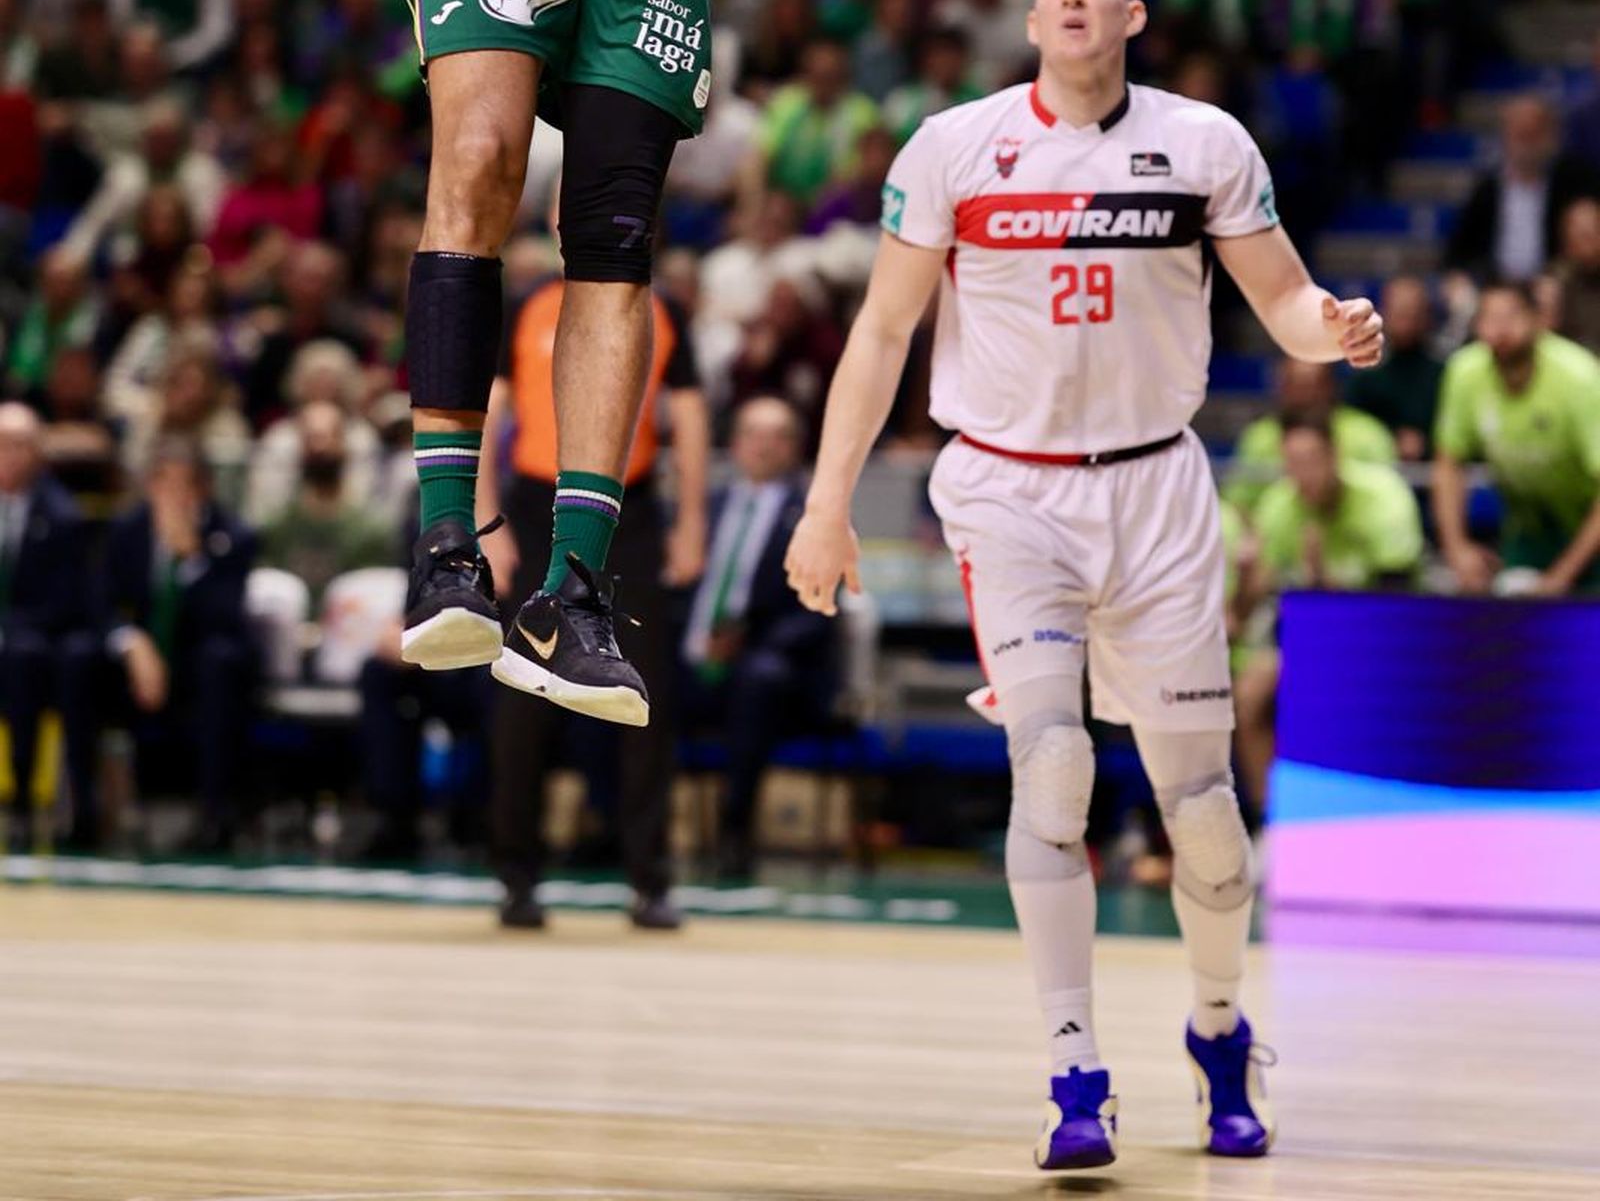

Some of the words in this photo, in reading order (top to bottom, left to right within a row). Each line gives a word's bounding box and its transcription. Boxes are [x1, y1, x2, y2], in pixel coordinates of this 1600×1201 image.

[633, 21, 695, 74] laga
[651, 11, 704, 50] má
[1051, 263, 1113, 325] 29
